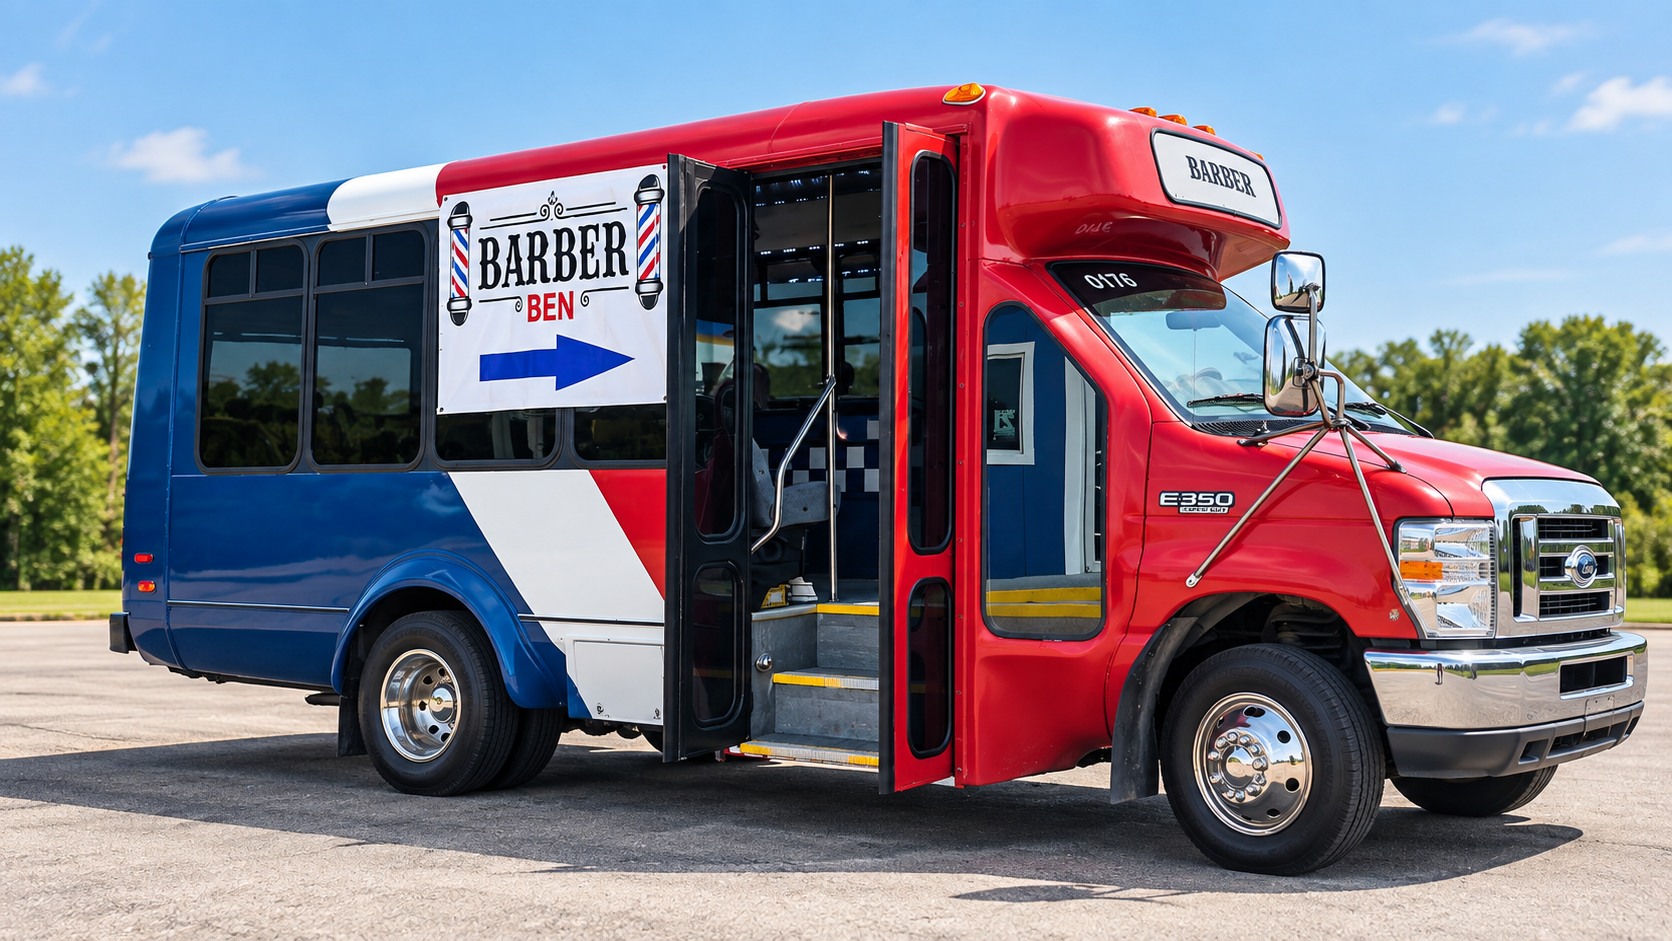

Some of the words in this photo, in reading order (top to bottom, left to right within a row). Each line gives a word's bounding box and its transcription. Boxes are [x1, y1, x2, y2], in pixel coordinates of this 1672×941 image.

[1185, 155, 1256, 198] BARBER
[478, 221, 629, 290] BARBER
[1084, 272, 1138, 289] 0176
[527, 291, 574, 323] BEN
